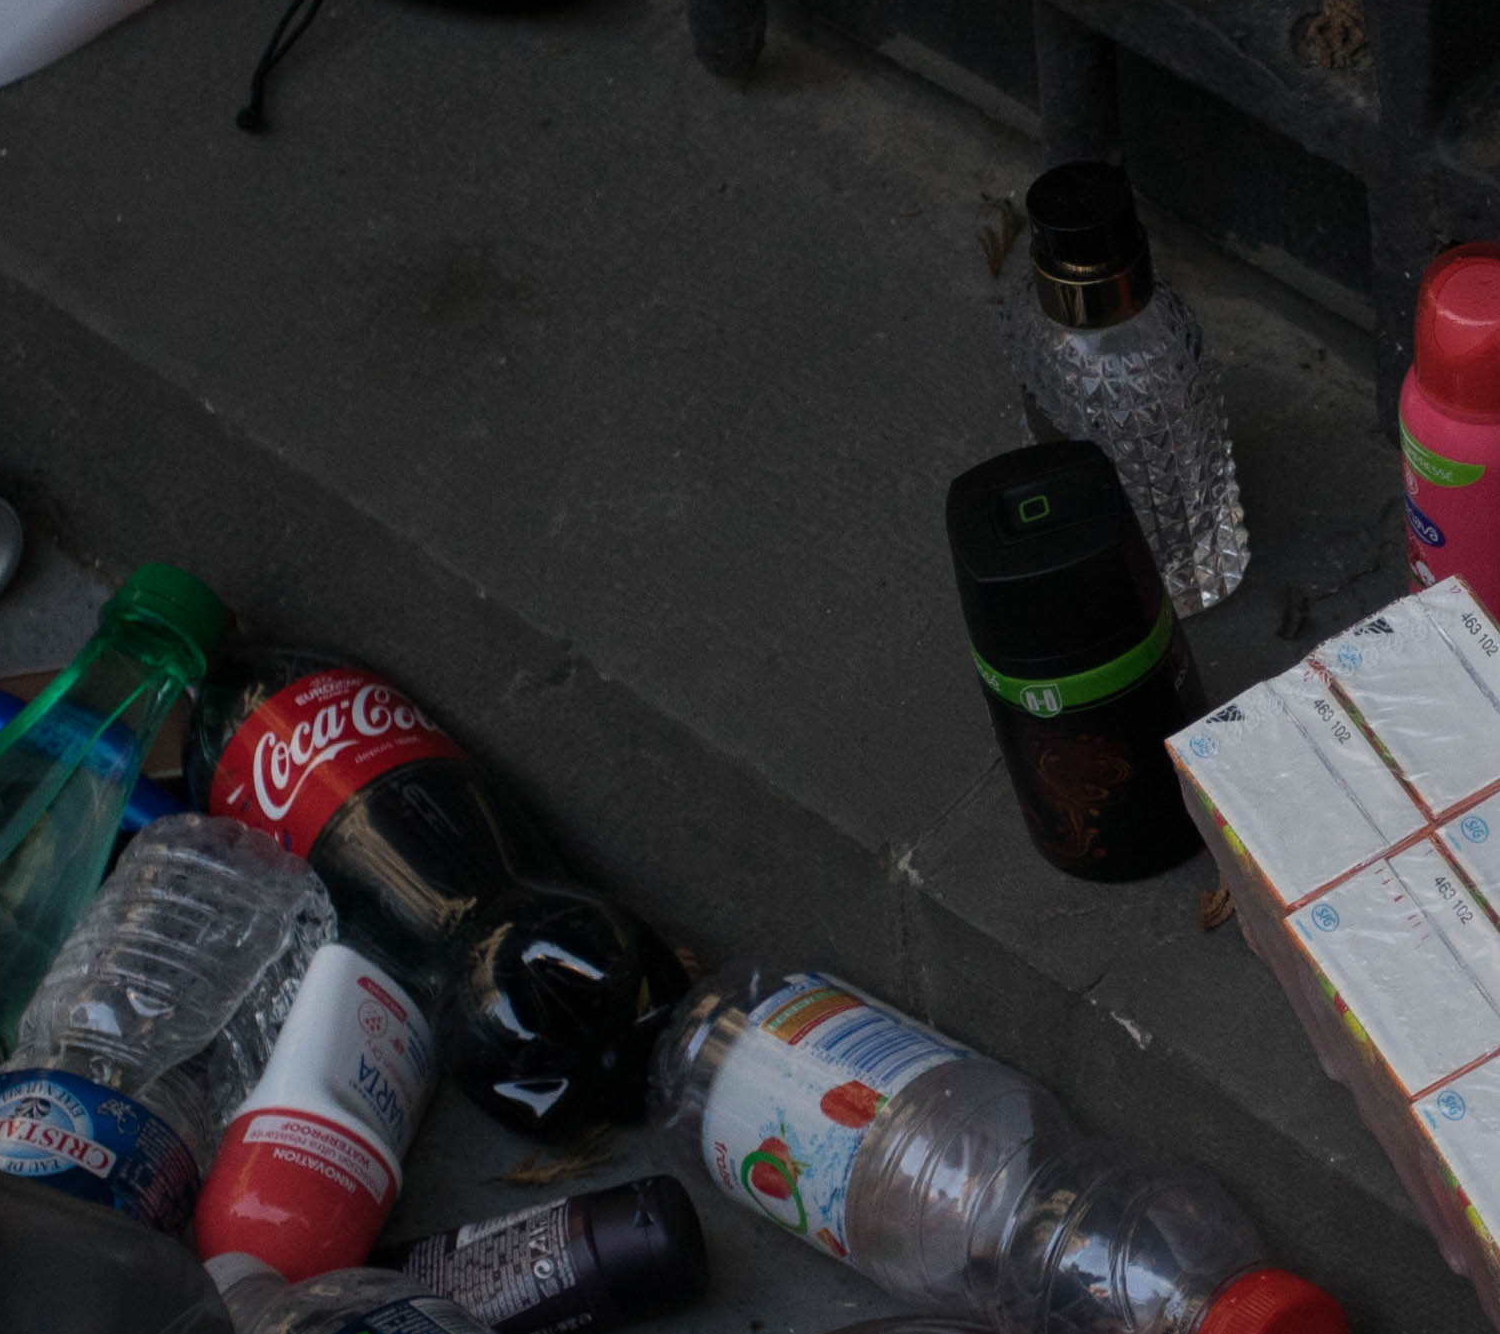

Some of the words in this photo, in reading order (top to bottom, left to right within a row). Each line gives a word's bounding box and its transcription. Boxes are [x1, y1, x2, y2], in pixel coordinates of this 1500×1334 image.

[1461, 611, 1482, 636] 463
[1476, 634, 1499, 658] 102
[1313, 698, 1336, 722] 463
[1330, 721, 1352, 745] 102
[253, 683, 438, 821] Coca-Co
[1434, 875, 1455, 899] 463
[1451, 898, 1473, 925] 102
[279, 1121, 370, 1169] WATERPROOF
[272, 1146, 358, 1195] INNOVATION
